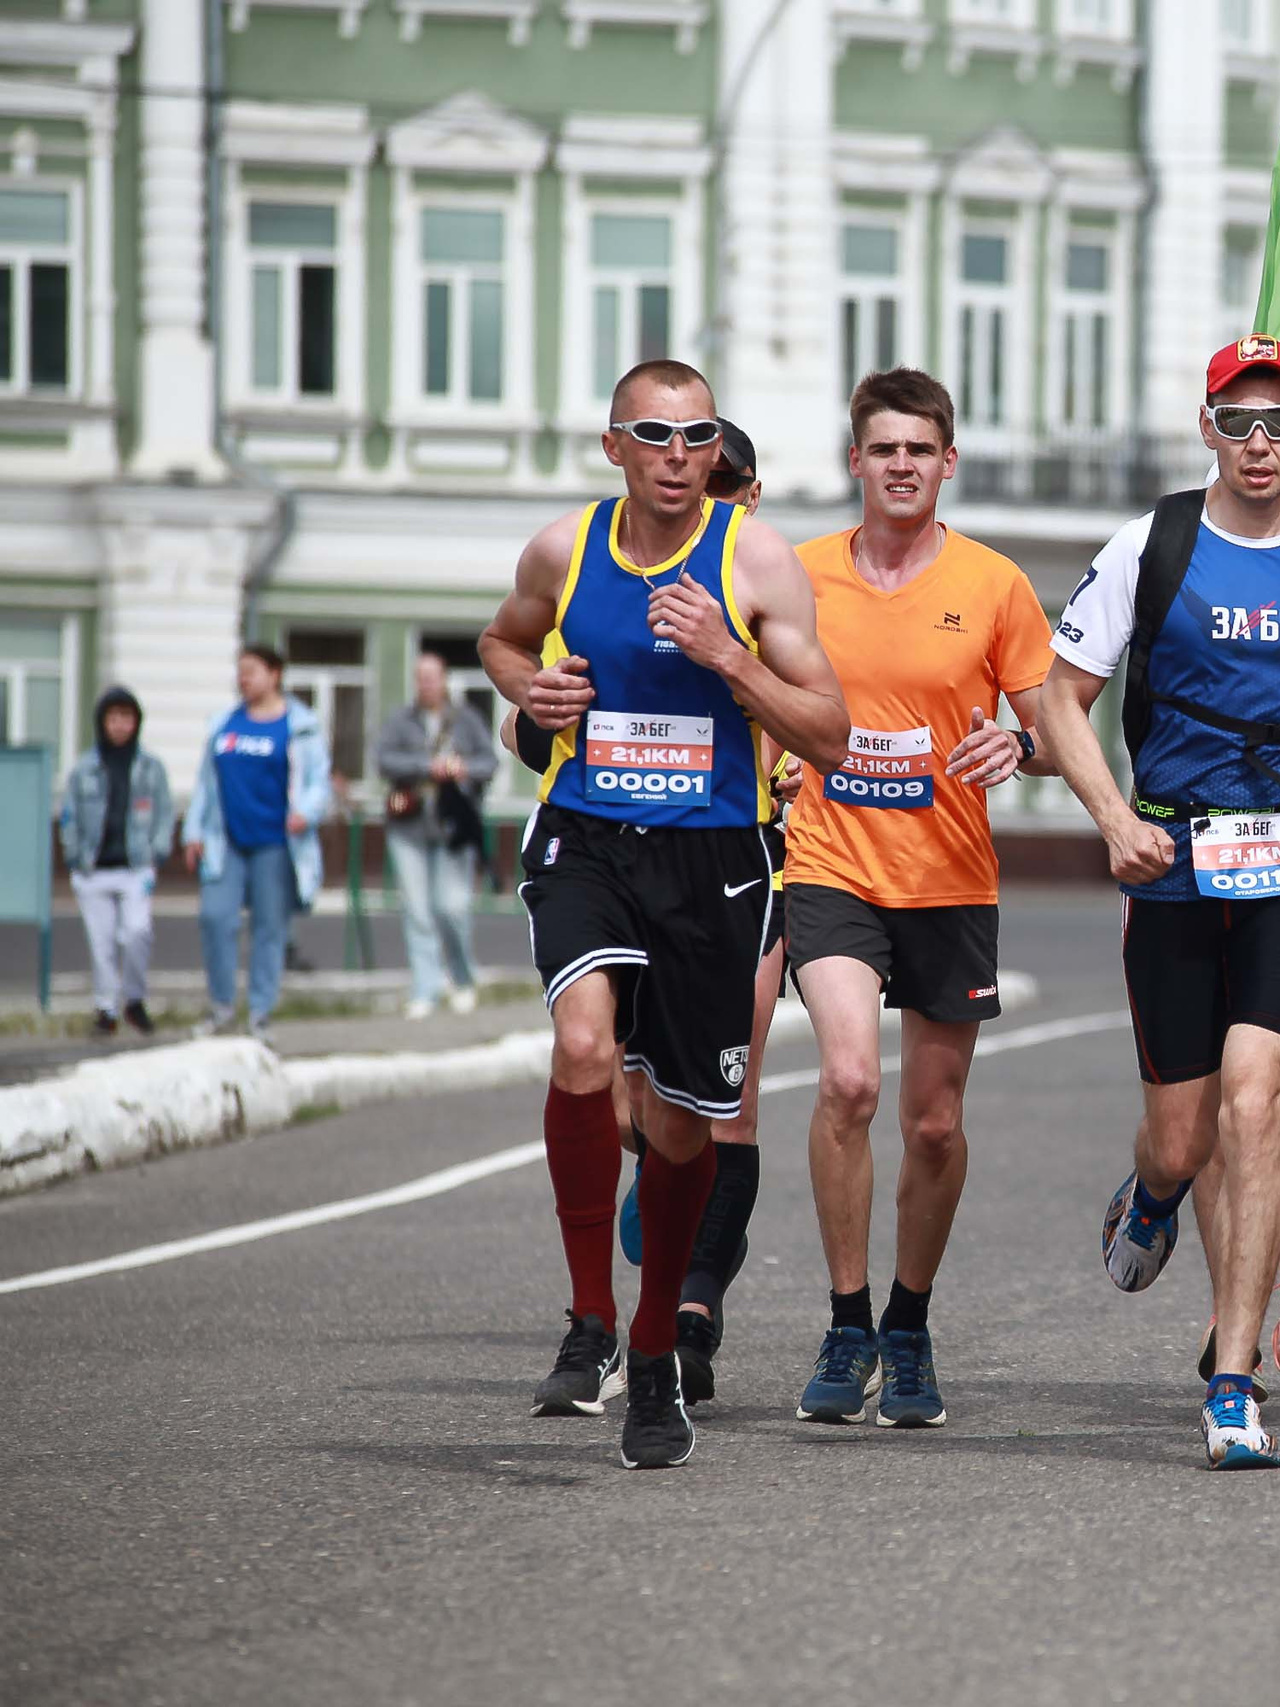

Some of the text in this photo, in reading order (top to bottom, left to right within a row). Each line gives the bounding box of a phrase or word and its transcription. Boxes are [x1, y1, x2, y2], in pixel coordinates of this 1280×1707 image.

[1056, 619, 1085, 643] 23
[595, 771, 704, 793] 00001
[830, 774, 924, 798] 00109
